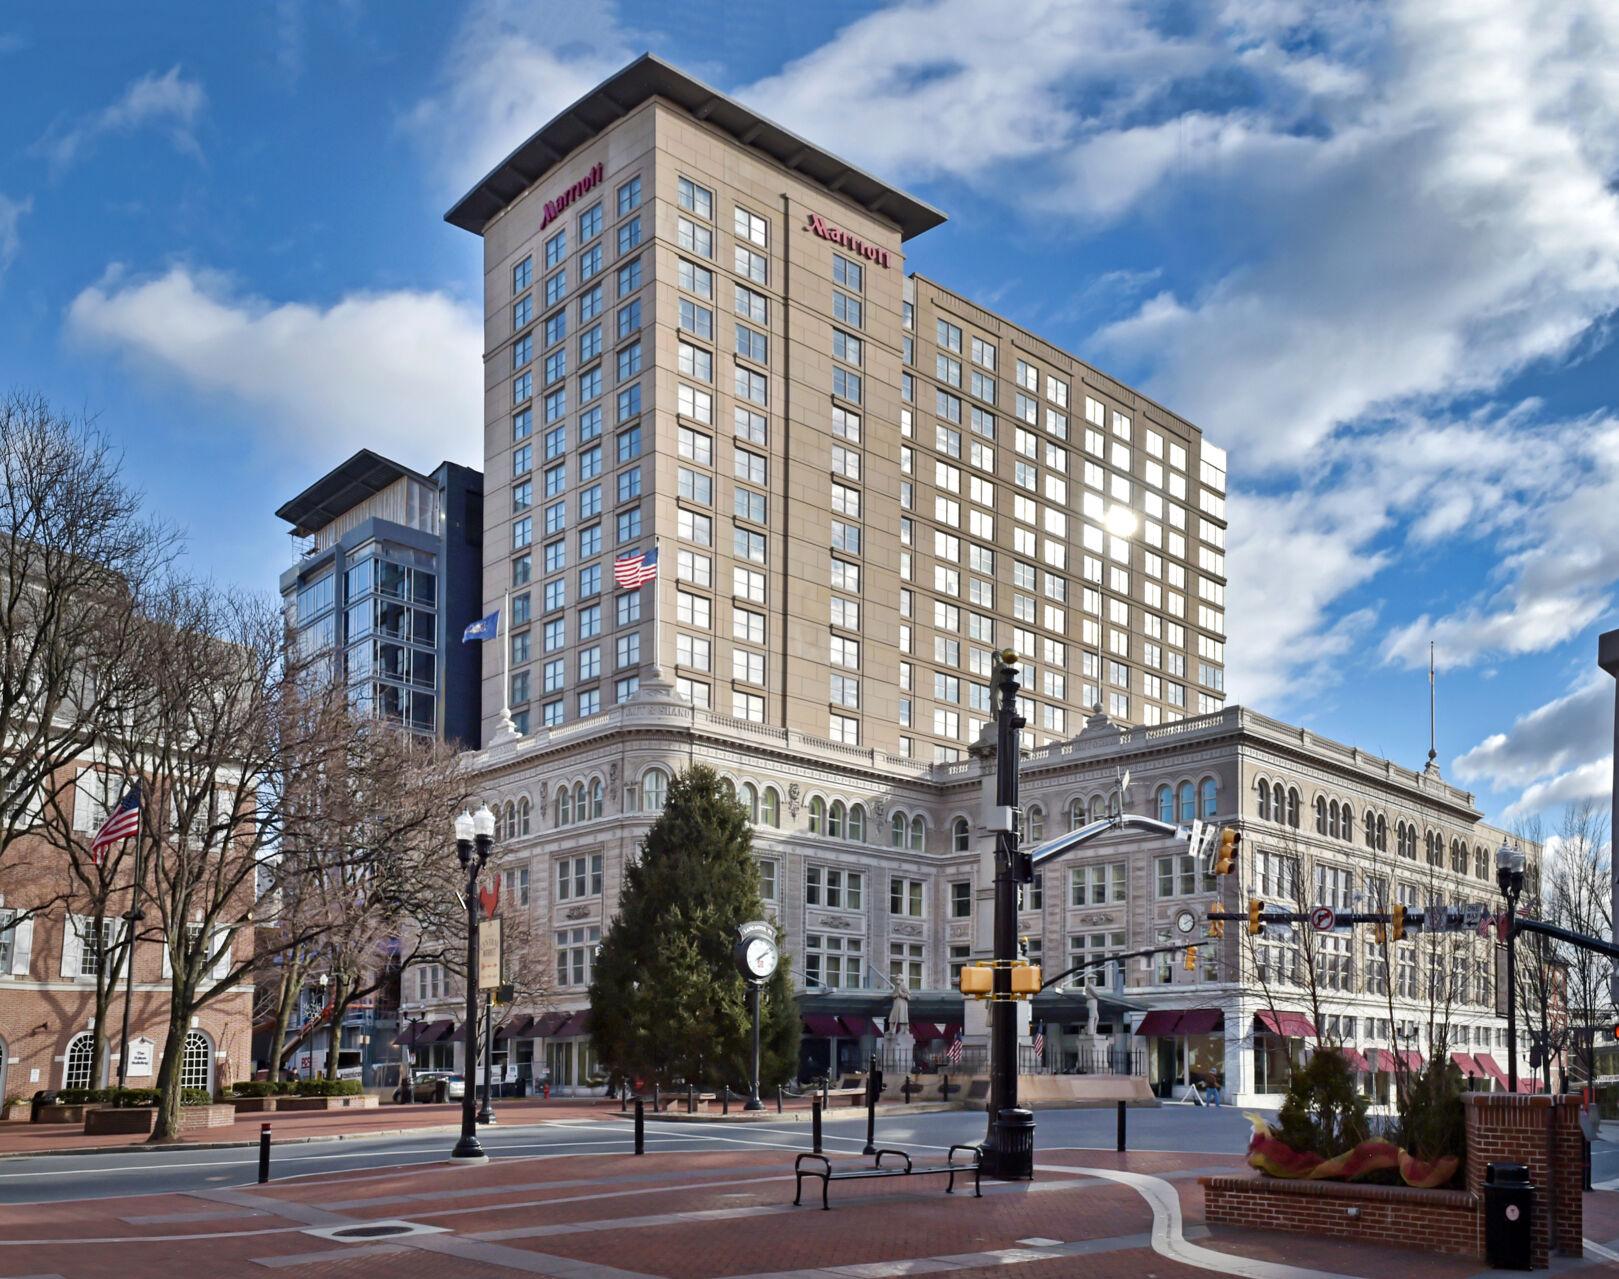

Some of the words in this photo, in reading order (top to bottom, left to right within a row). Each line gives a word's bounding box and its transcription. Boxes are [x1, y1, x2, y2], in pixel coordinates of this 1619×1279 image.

[540, 161, 603, 230] Marriott
[803, 213, 892, 269] Marriott
[1466, 912, 1479, 920] WAY
[1467, 904, 1481, 912] ONE
